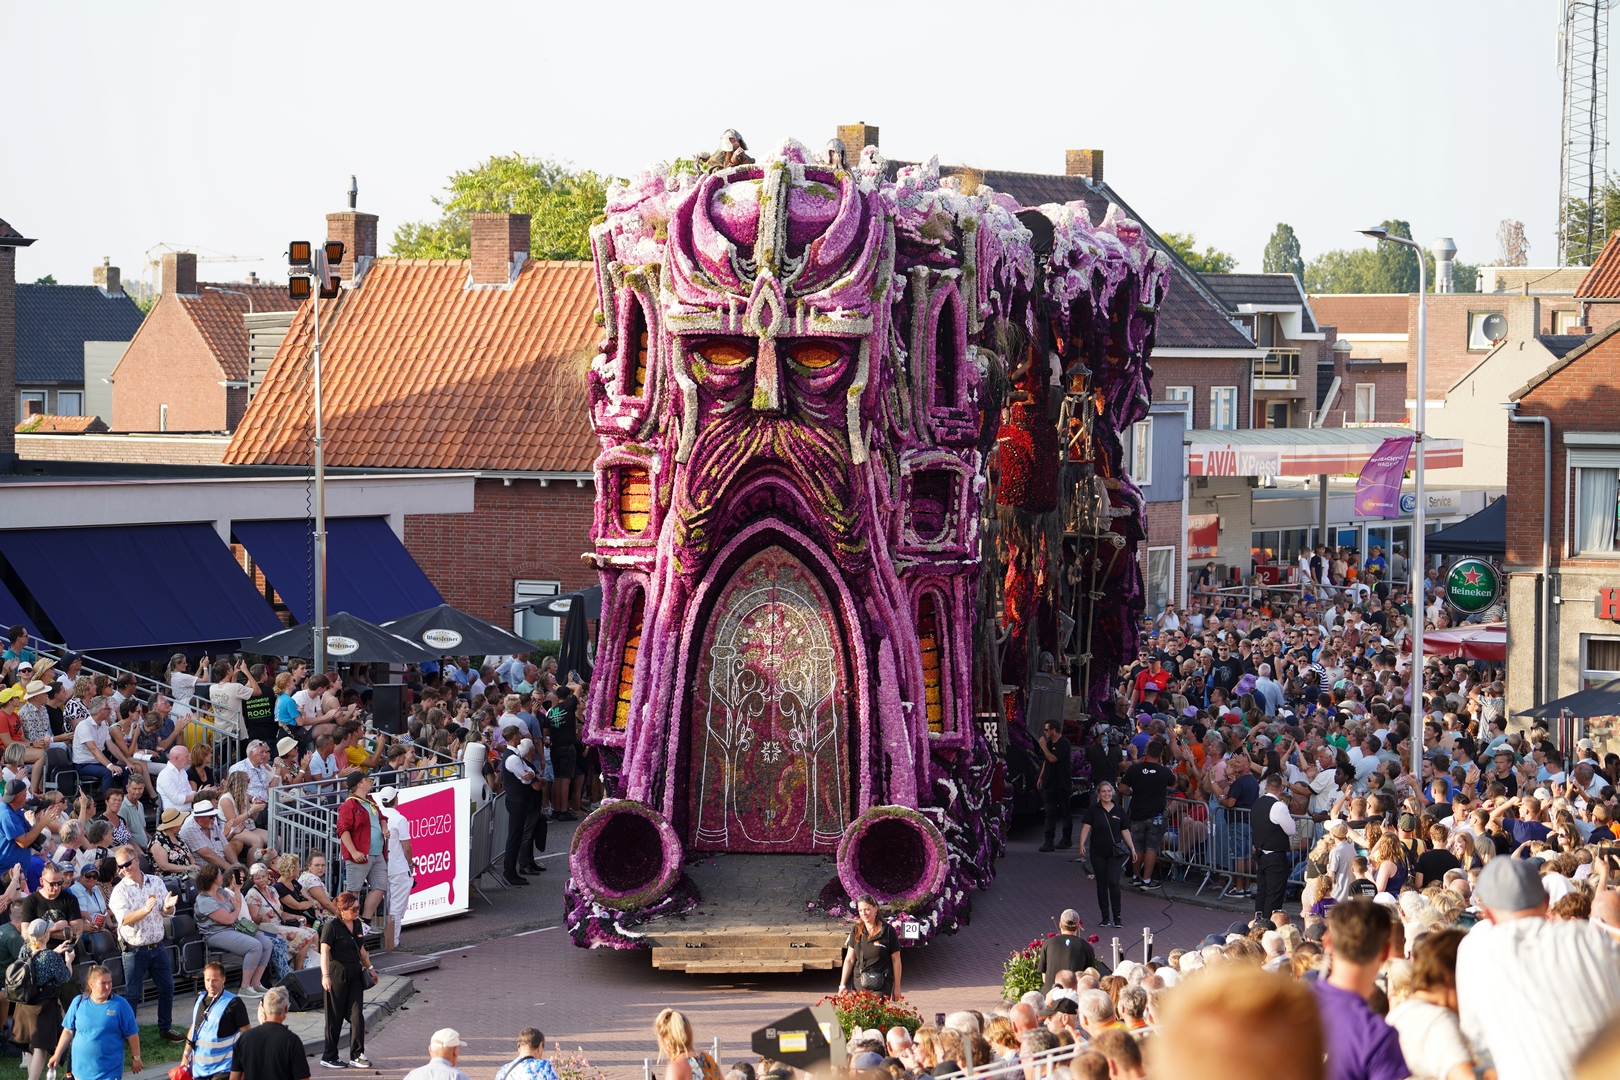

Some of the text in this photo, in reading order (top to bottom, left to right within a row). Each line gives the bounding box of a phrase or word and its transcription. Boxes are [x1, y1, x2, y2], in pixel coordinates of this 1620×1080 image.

[1429, 496, 1451, 507] Service
[1263, 571, 1270, 582] 2
[1451, 586, 1492, 597] Heineken
[247, 708, 272, 717] ROOK
[411, 850, 451, 876] reeze
[428, 896, 446, 907] FRUITS
[905, 924, 917, 933] 20
